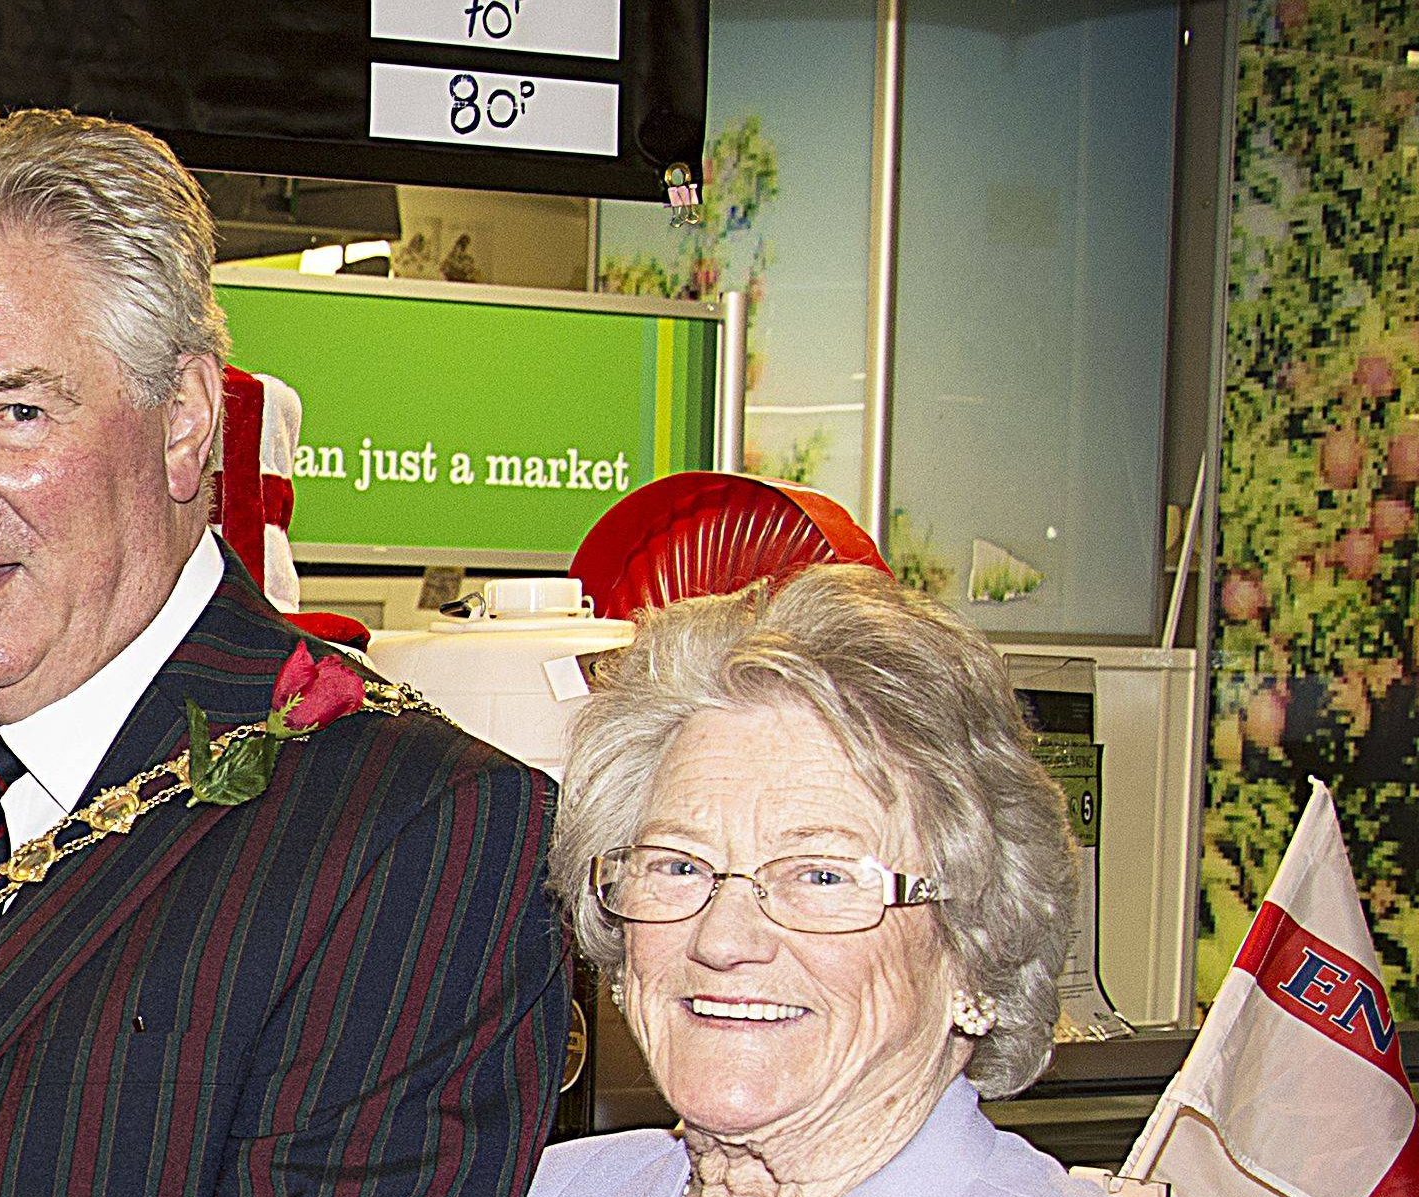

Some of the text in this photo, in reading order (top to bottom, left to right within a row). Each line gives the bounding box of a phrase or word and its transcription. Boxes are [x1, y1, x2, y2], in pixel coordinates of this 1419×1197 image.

[355, 438, 438, 491] just
[450, 452, 474, 479] a
[486, 449, 629, 491] market
